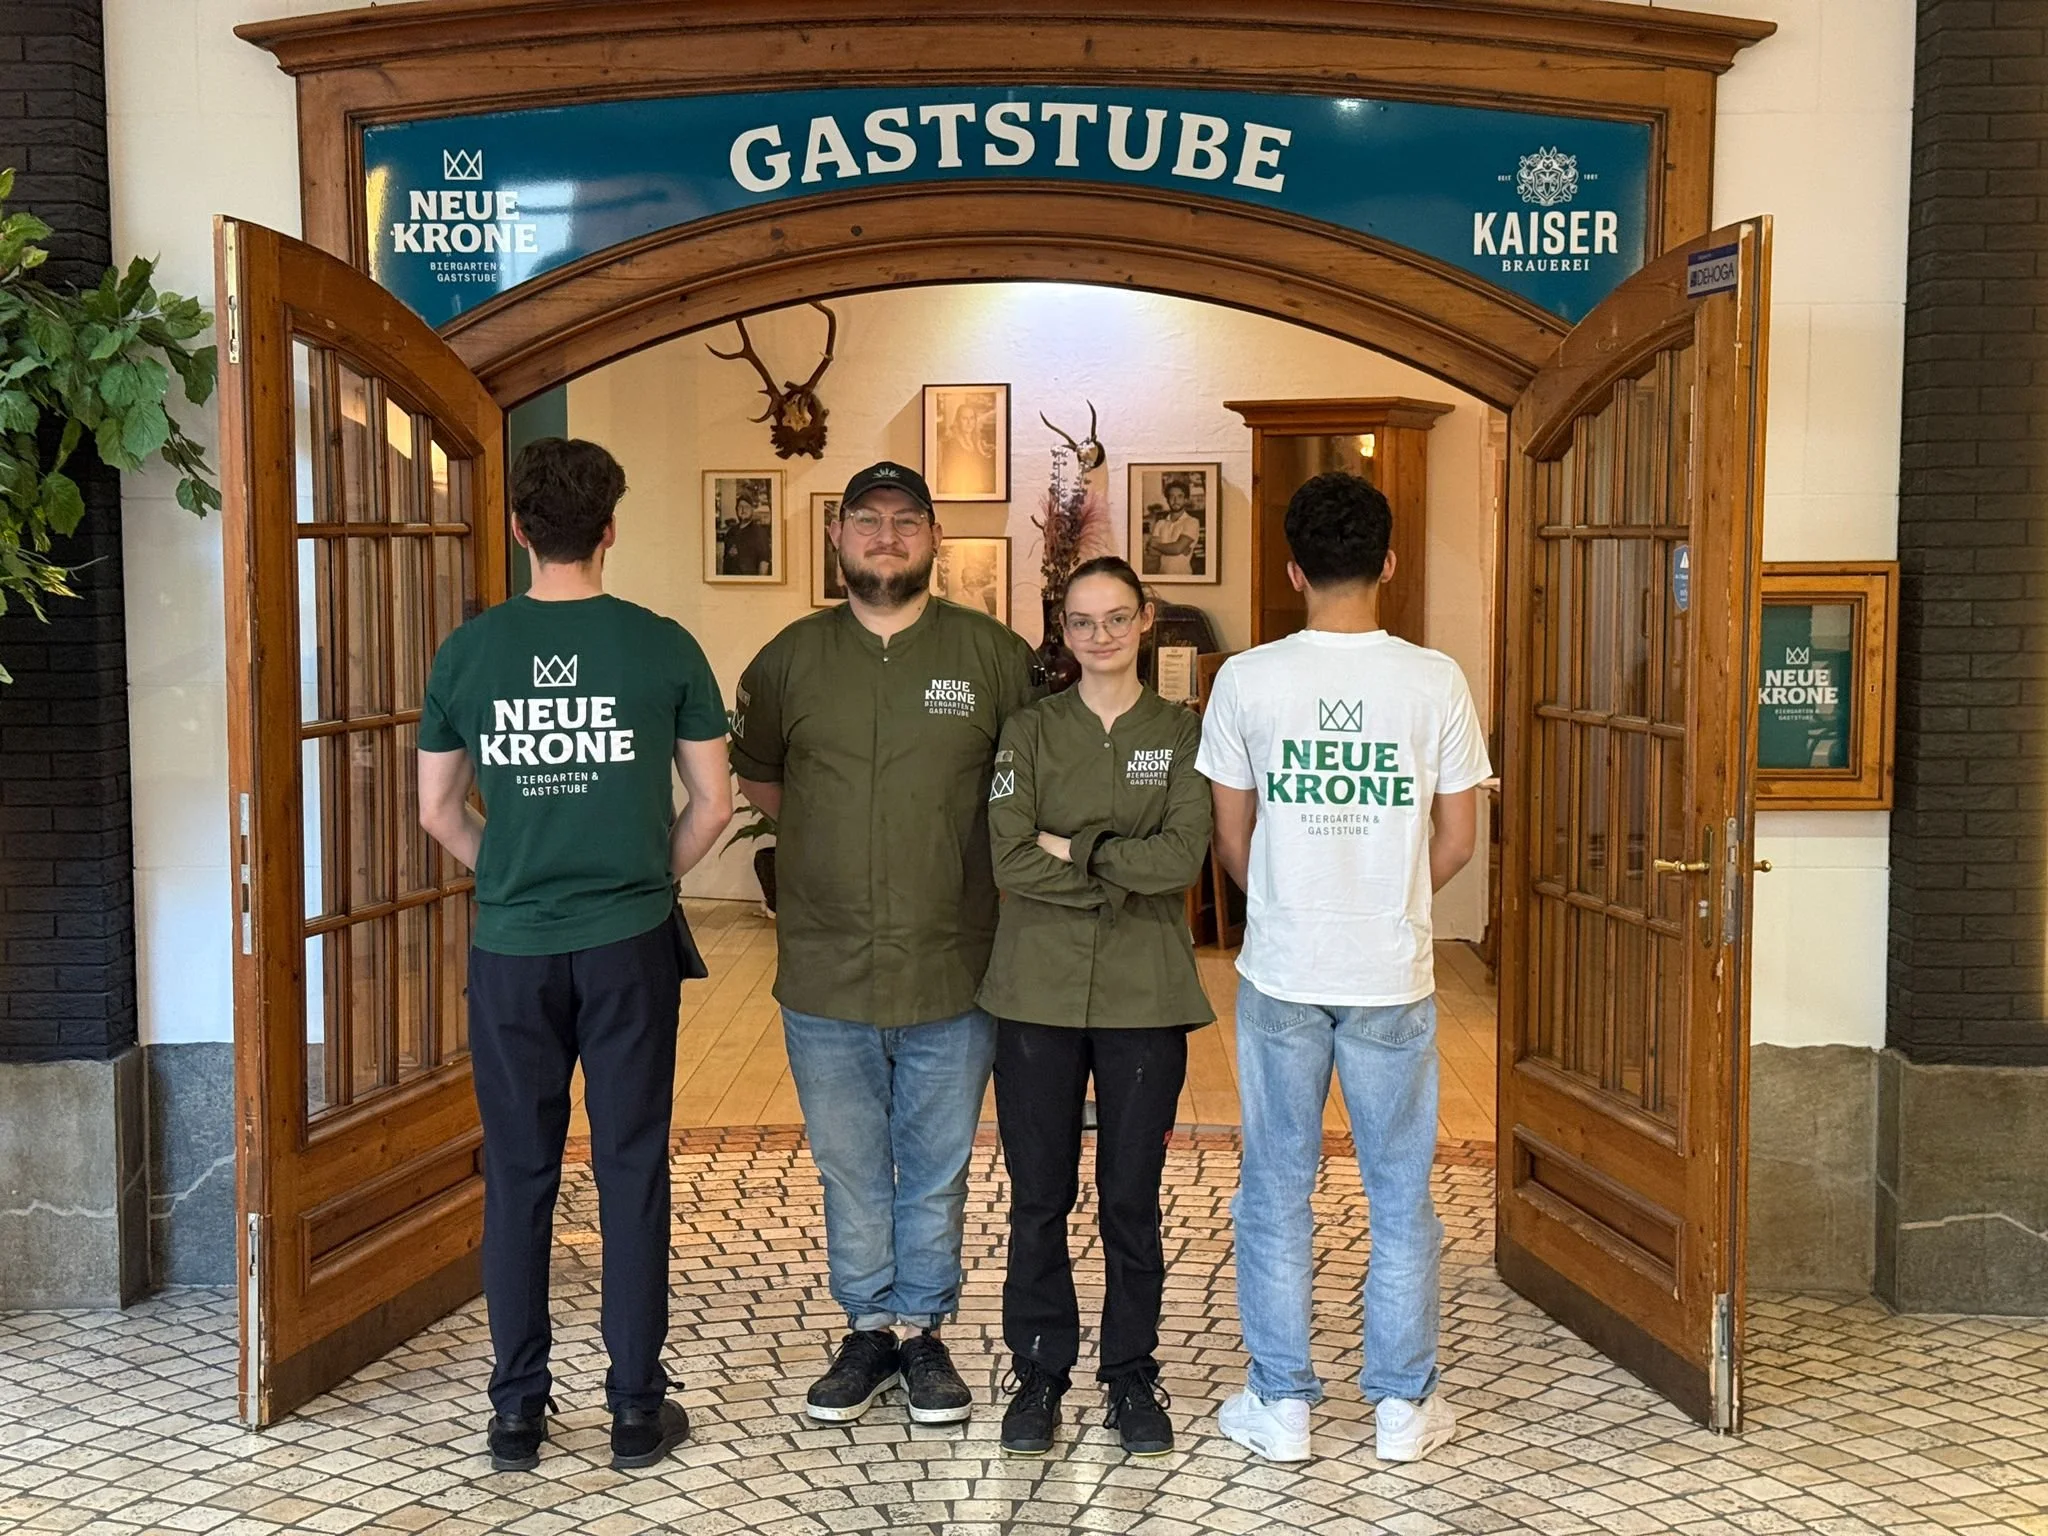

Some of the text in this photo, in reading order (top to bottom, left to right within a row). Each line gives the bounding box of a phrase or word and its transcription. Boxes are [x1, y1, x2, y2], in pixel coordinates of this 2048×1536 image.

[729, 102, 1292, 193] GASTSTUBE
[410, 190, 520, 220] NEUE
[393, 223, 538, 253] KRONE
[1473, 211, 1618, 256] KAISER
[430, 262, 497, 271] BIERGARTEN
[1502, 259, 1589, 272] BRAUEREI
[437, 273, 497, 282] GASTSTUBE
[1697, 262, 1735, 286] DEHOGA
[931, 679, 970, 692] NEUE
[1765, 669, 1829, 687] NEUE
[924, 689, 976, 705] KRONE
[1758, 687, 1839, 705] KRONE
[924, 701, 969, 710] BIERGARTEN
[929, 708, 969, 717] GASTSTUBE
[493, 696, 616, 731] NEUE
[479, 729, 636, 765] KRONE
[1134, 749, 1173, 760] NEUE
[1282, 740, 1398, 772] NEUE
[1127, 760, 1170, 771] KRON
[516, 771, 600, 785] BIERGARTEN &
[522, 783, 589, 797] GASTSTUBE
[1267, 772, 1414, 806] KRONE
[1301, 814, 1381, 824] BIERGARTEN &
[1308, 826, 1369, 835] GASTSTUBE
